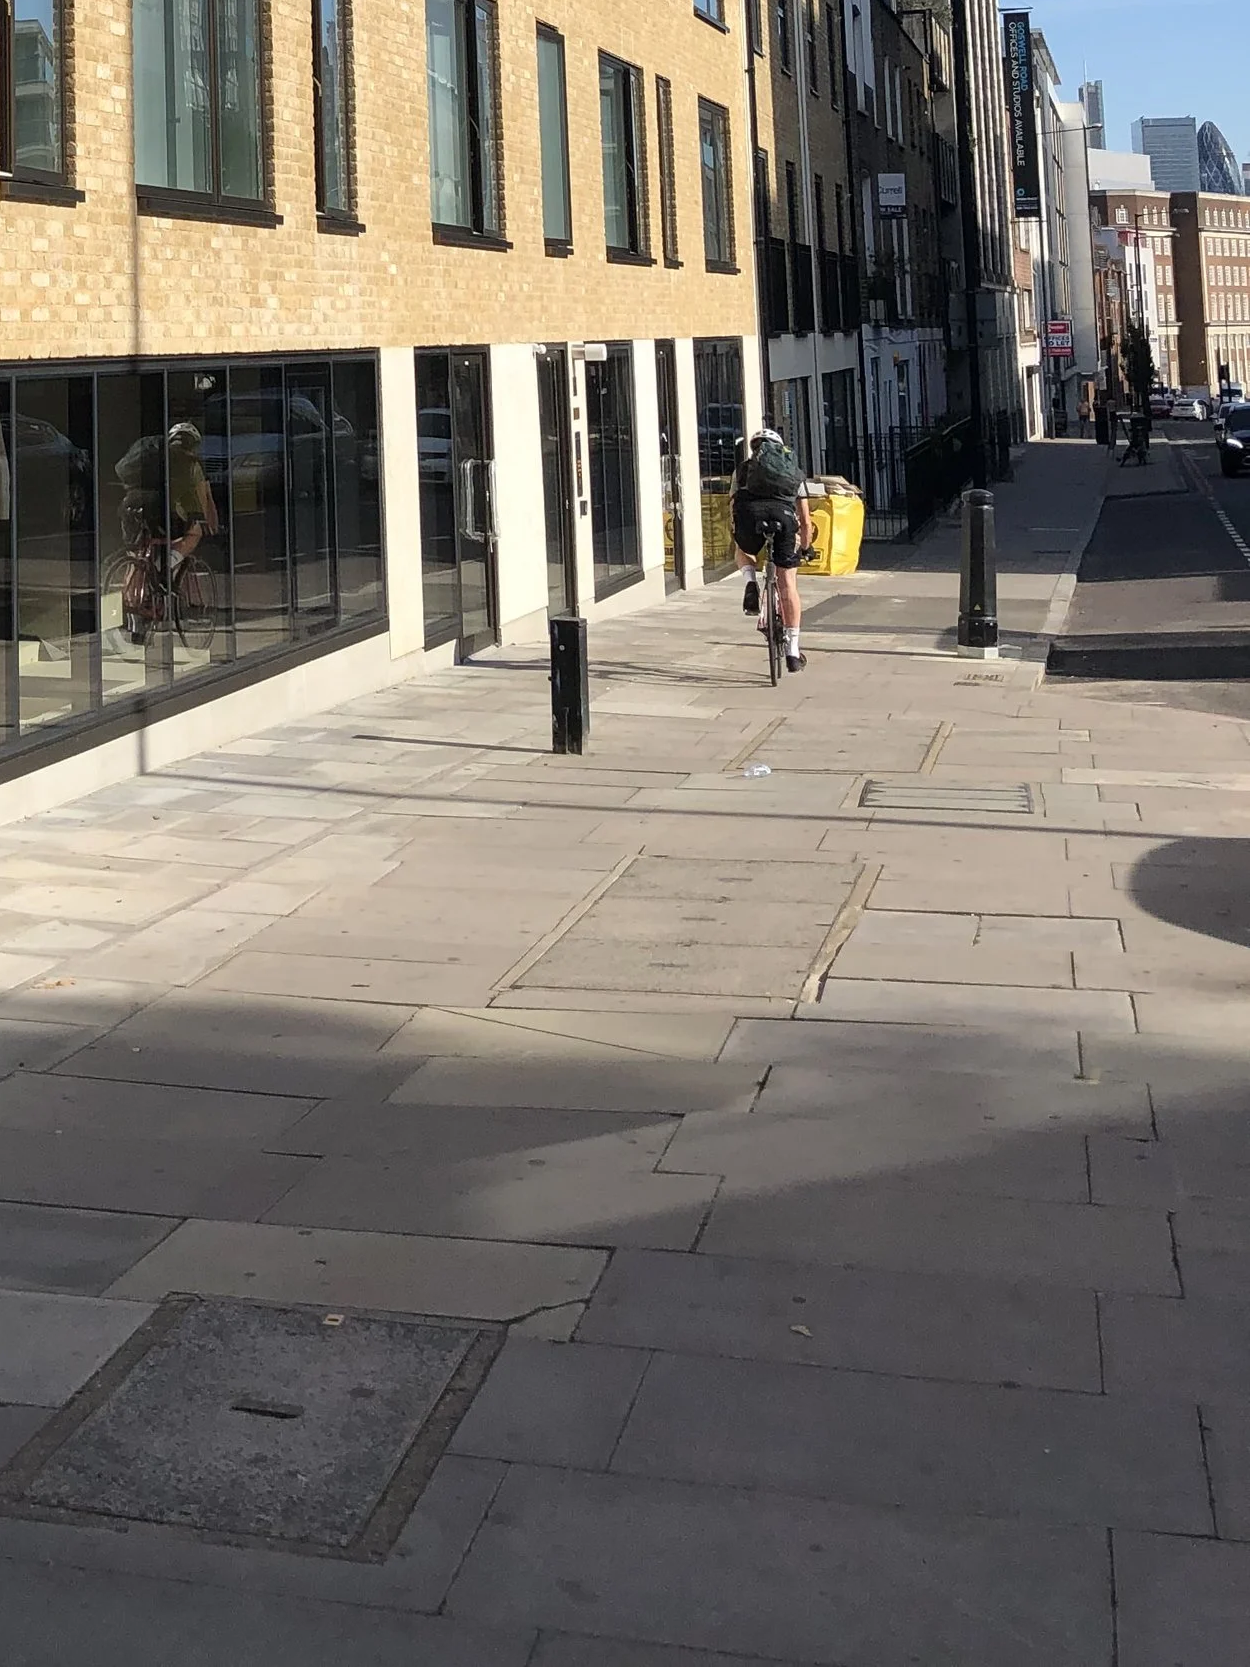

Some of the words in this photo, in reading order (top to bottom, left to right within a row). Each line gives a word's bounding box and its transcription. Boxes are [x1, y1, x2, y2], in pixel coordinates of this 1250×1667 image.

[1009, 22, 1018, 58] OFFICES
[1017, 22, 1026, 64] GOSWELL
[1011, 60, 1020, 79] AND
[1019, 66, 1028, 91] ROAD
[1012, 81, 1022, 117] STUDIOS
[1015, 119, 1026, 166] AVAILABLE
